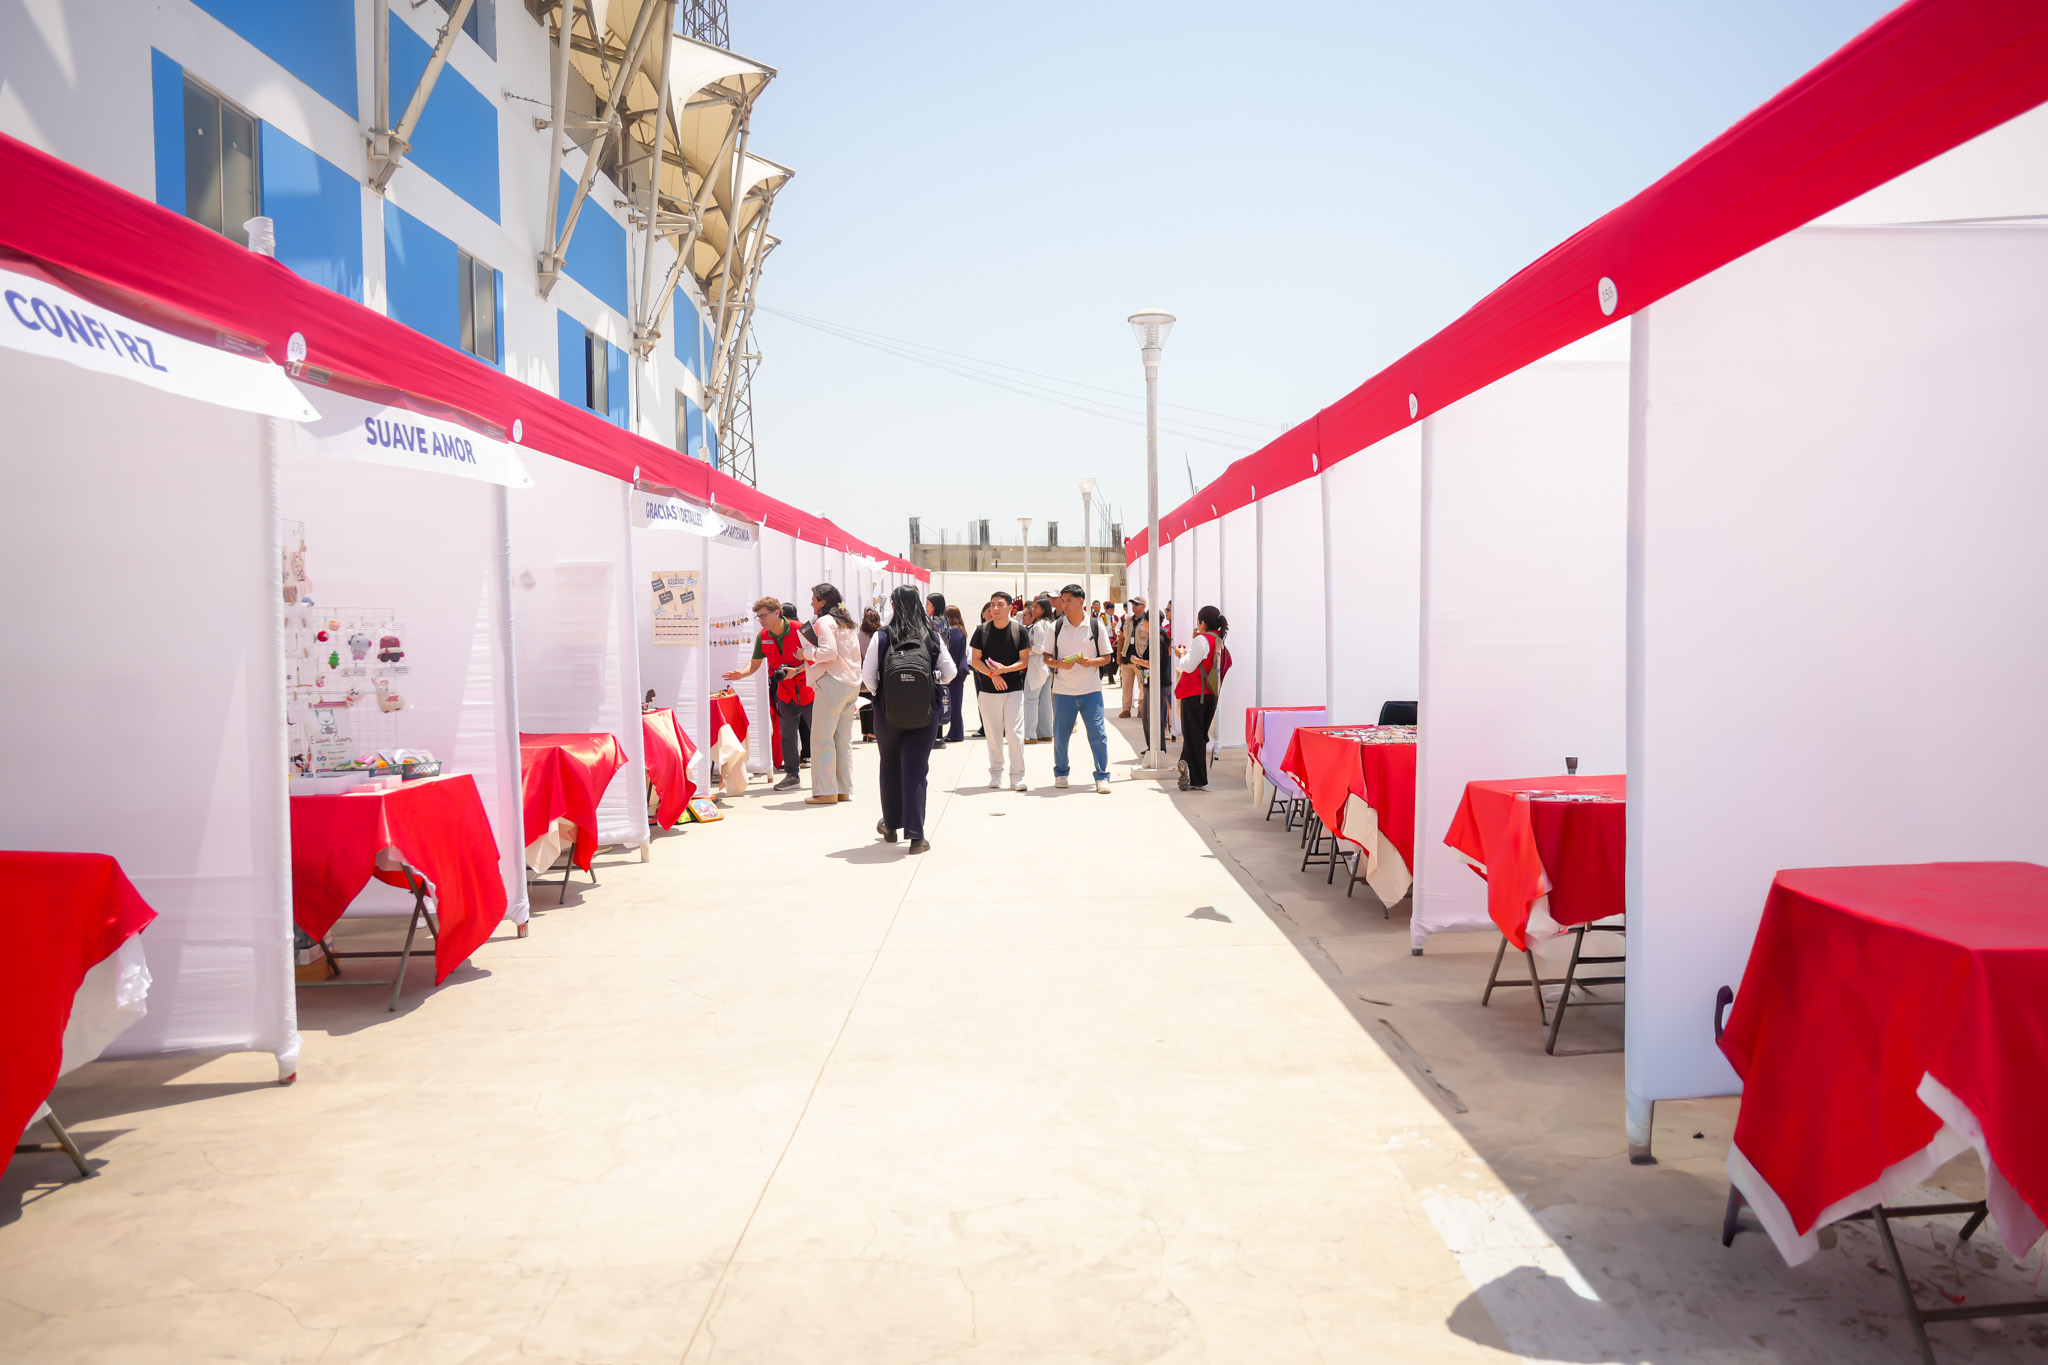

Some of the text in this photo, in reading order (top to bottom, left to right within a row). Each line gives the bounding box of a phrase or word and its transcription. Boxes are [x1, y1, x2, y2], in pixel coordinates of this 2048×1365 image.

[1601, 286, 1614, 303] 155
[290, 341, 304, 355] 176
[364, 416, 477, 464] SUAVE AMOR
[645, 501, 678, 521] GRACIAS
